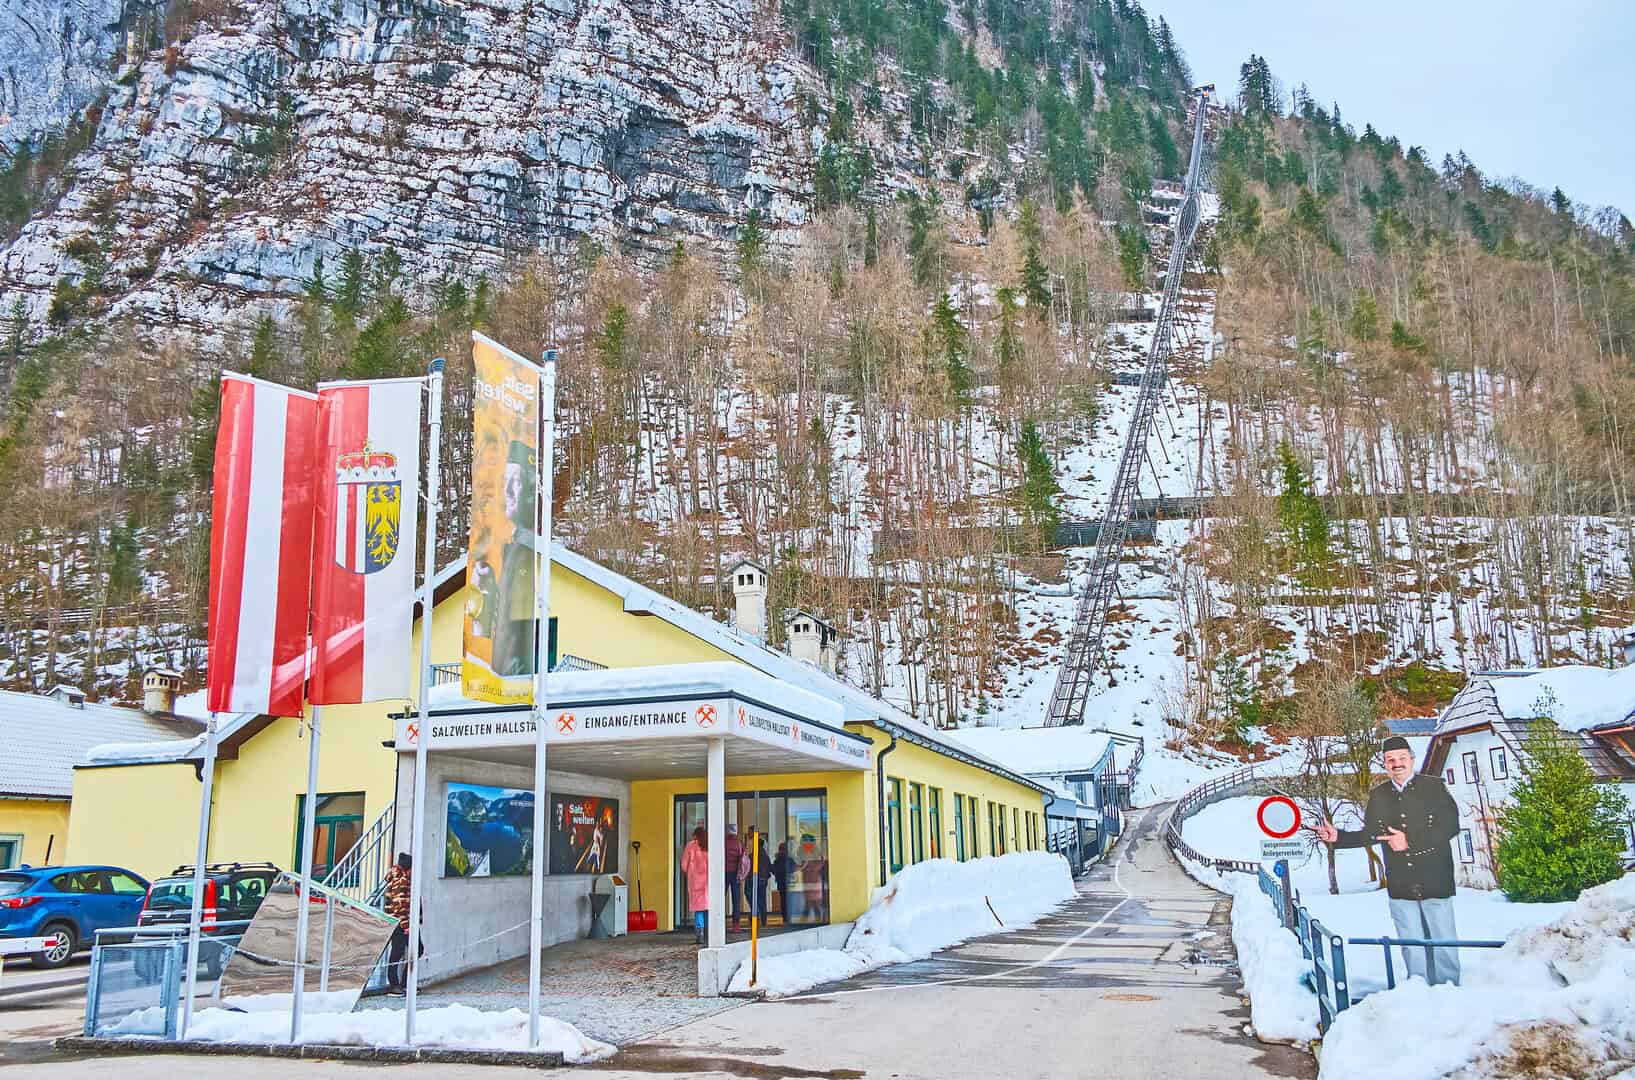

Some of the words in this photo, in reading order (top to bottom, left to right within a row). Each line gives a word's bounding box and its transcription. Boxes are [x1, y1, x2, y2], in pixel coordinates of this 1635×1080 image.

[432, 722, 492, 738] SALZWELTEN
[495, 720, 537, 734] HALLSTA
[584, 711, 687, 729] EINGANG/ENTRANCE
[573, 811, 594, 824] welten
